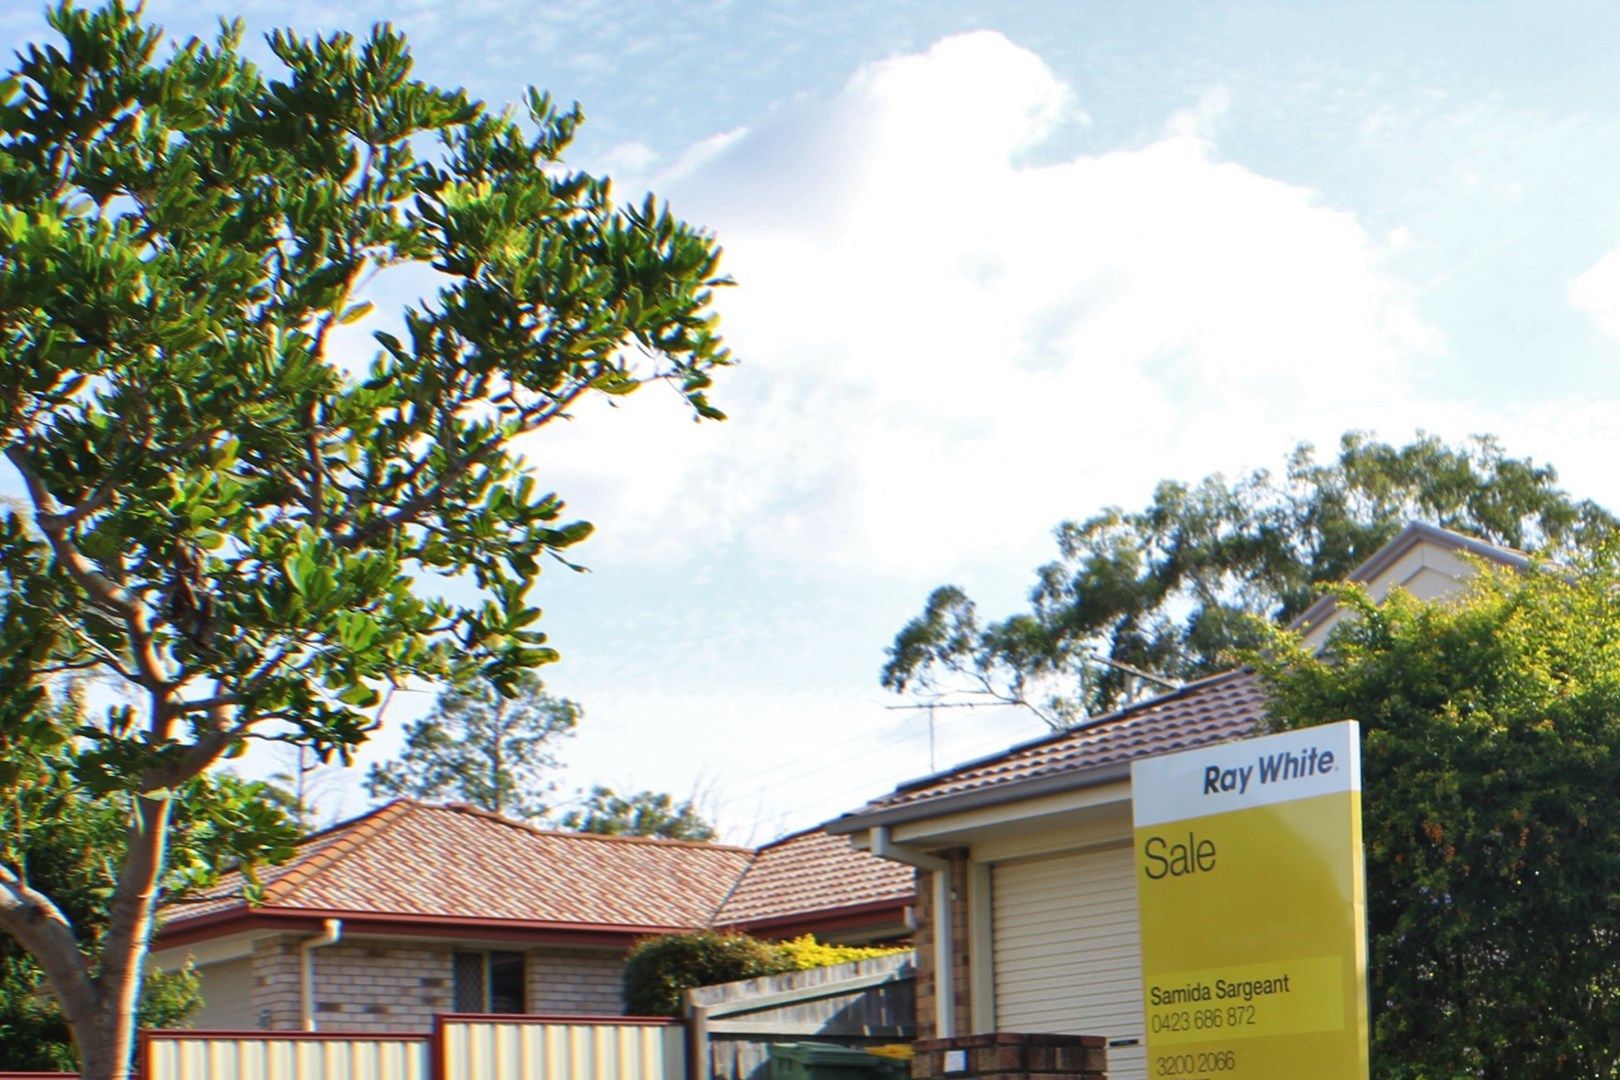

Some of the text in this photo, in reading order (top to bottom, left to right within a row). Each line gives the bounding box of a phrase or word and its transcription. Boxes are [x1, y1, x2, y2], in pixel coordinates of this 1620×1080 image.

[1203, 747, 1335, 795] Ray White
[1144, 831, 1217, 880] Sale
[1150, 974, 1290, 1006] Samida Sargeant
[1151, 1005, 1256, 1033] 0423 686 872
[1156, 1050, 1236, 1076] 3200 2066
